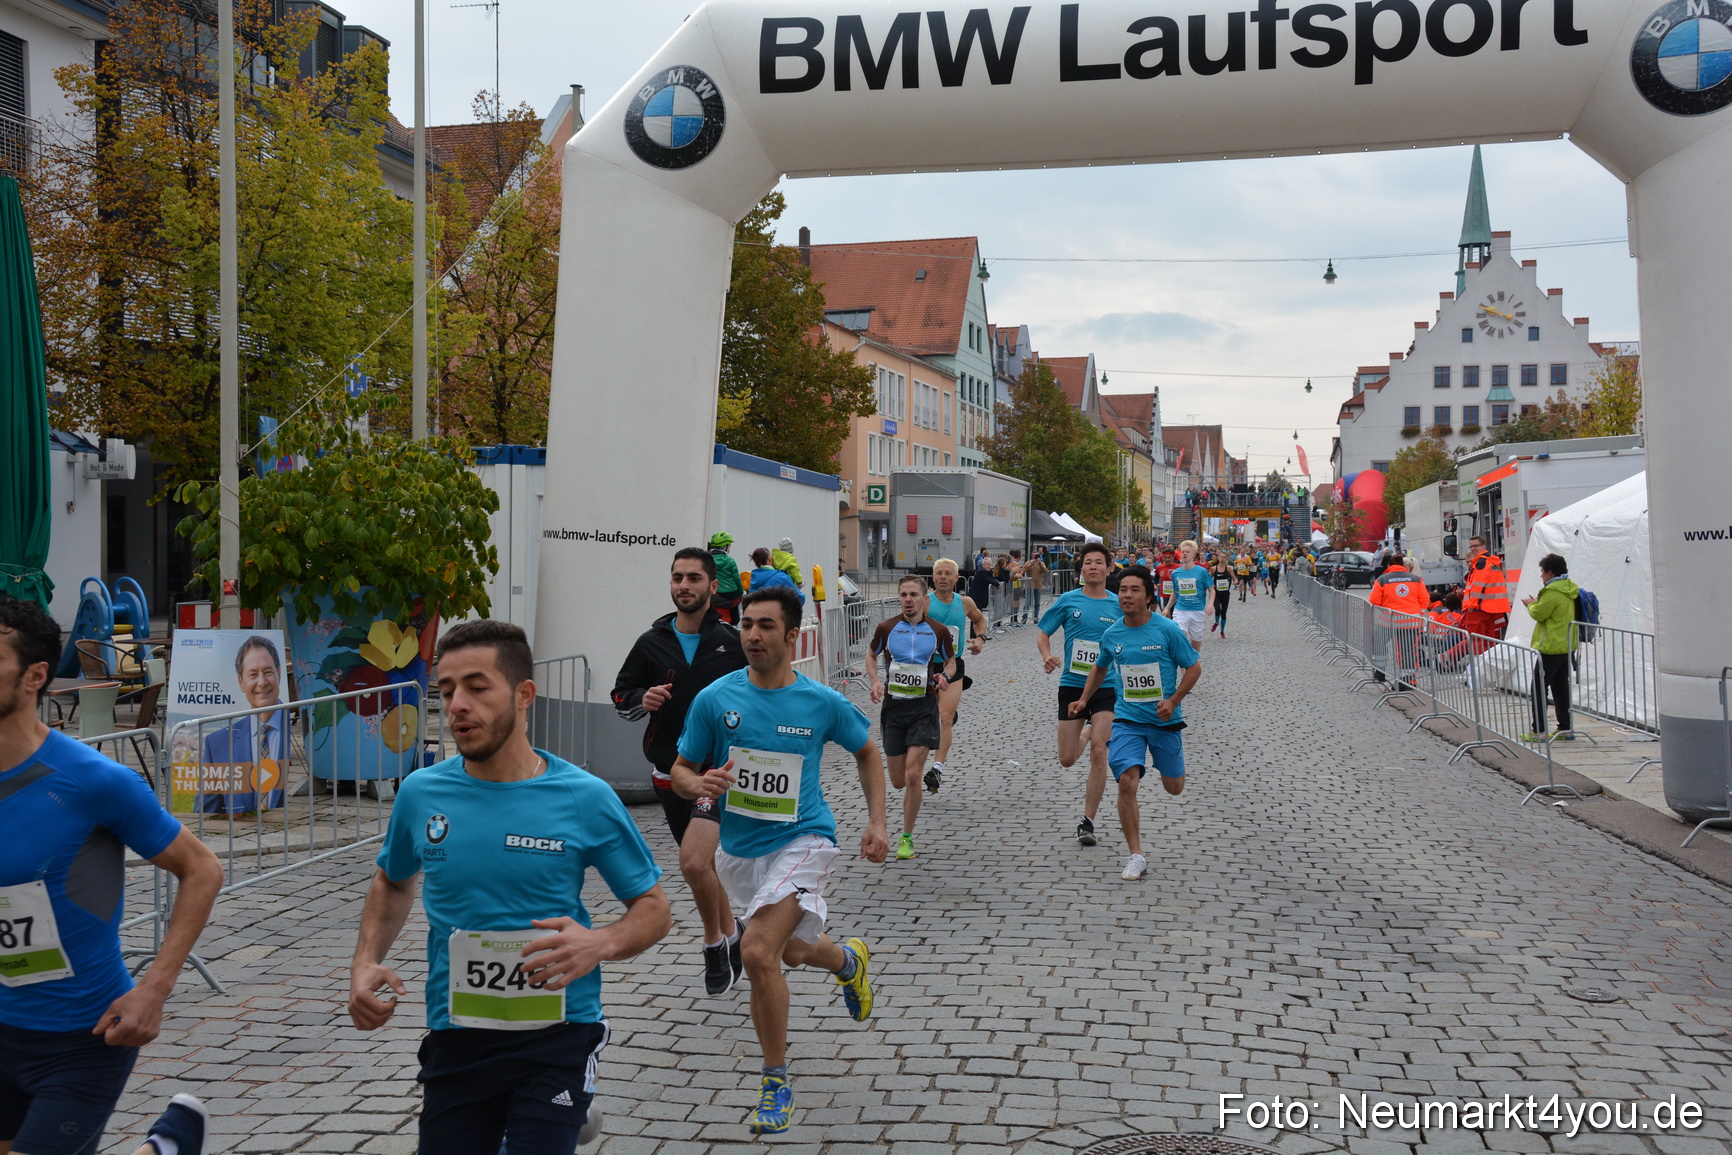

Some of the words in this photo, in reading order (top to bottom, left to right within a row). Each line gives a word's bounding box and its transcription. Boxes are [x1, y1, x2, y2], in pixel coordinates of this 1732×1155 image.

[1645, 0, 1732, 38] BM
[759, 6, 1032, 94] BMW
[1060, 0, 1588, 85] Laufsport
[638, 68, 717, 101] BMW
[109, 464, 124, 472] Mode
[870, 488, 883, 501] D
[543, 528, 677, 546] www.bmw-laufsport.de
[894, 673, 922, 686] 5206
[1127, 676, 1155, 688] 5196
[178, 681, 223, 692] WEITER.
[177, 694, 235, 704] MACHEN.
[777, 725, 812, 736] BOCK
[175, 766, 242, 779] THOMAS
[738, 768, 789, 794] 5180
[743, 797, 778, 808] Housseini
[505, 835, 565, 852] BOCK
[551, 1098, 573, 1106] adidas
